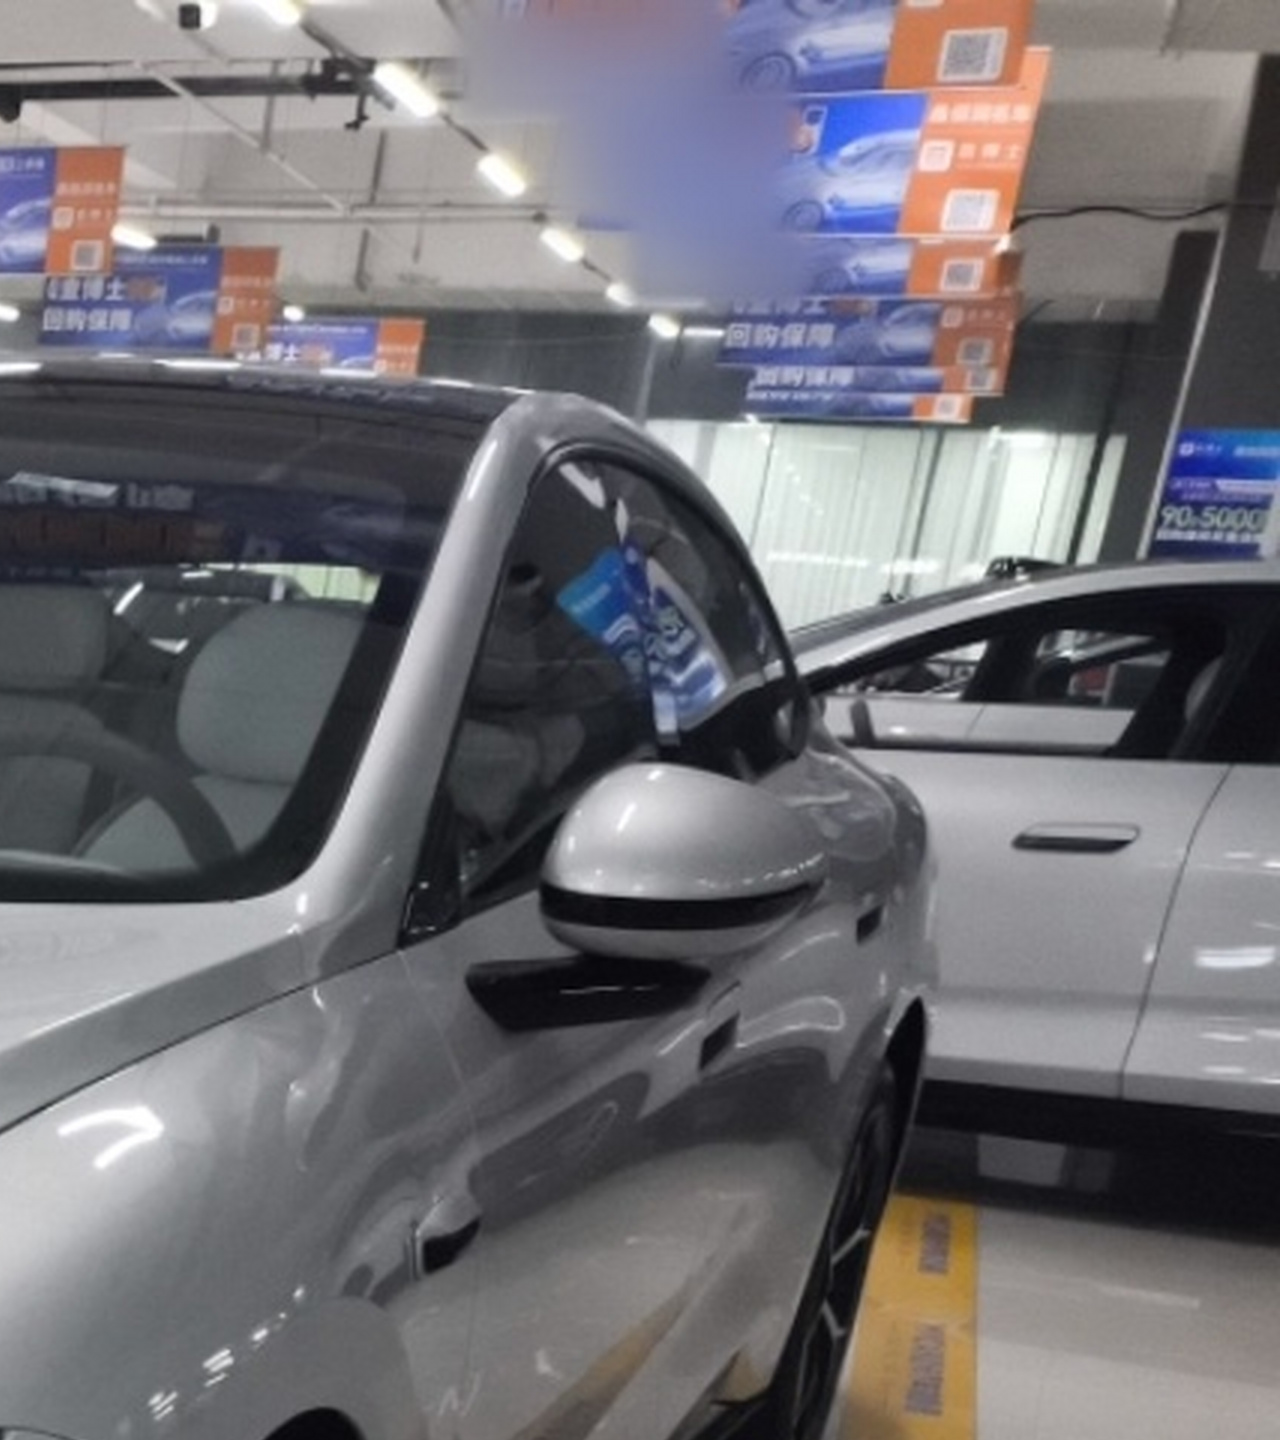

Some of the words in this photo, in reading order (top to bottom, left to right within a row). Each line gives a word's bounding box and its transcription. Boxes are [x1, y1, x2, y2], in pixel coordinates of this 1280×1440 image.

[42, 308, 133, 332] 回购保障
[724, 323, 835, 348] 回购保障
